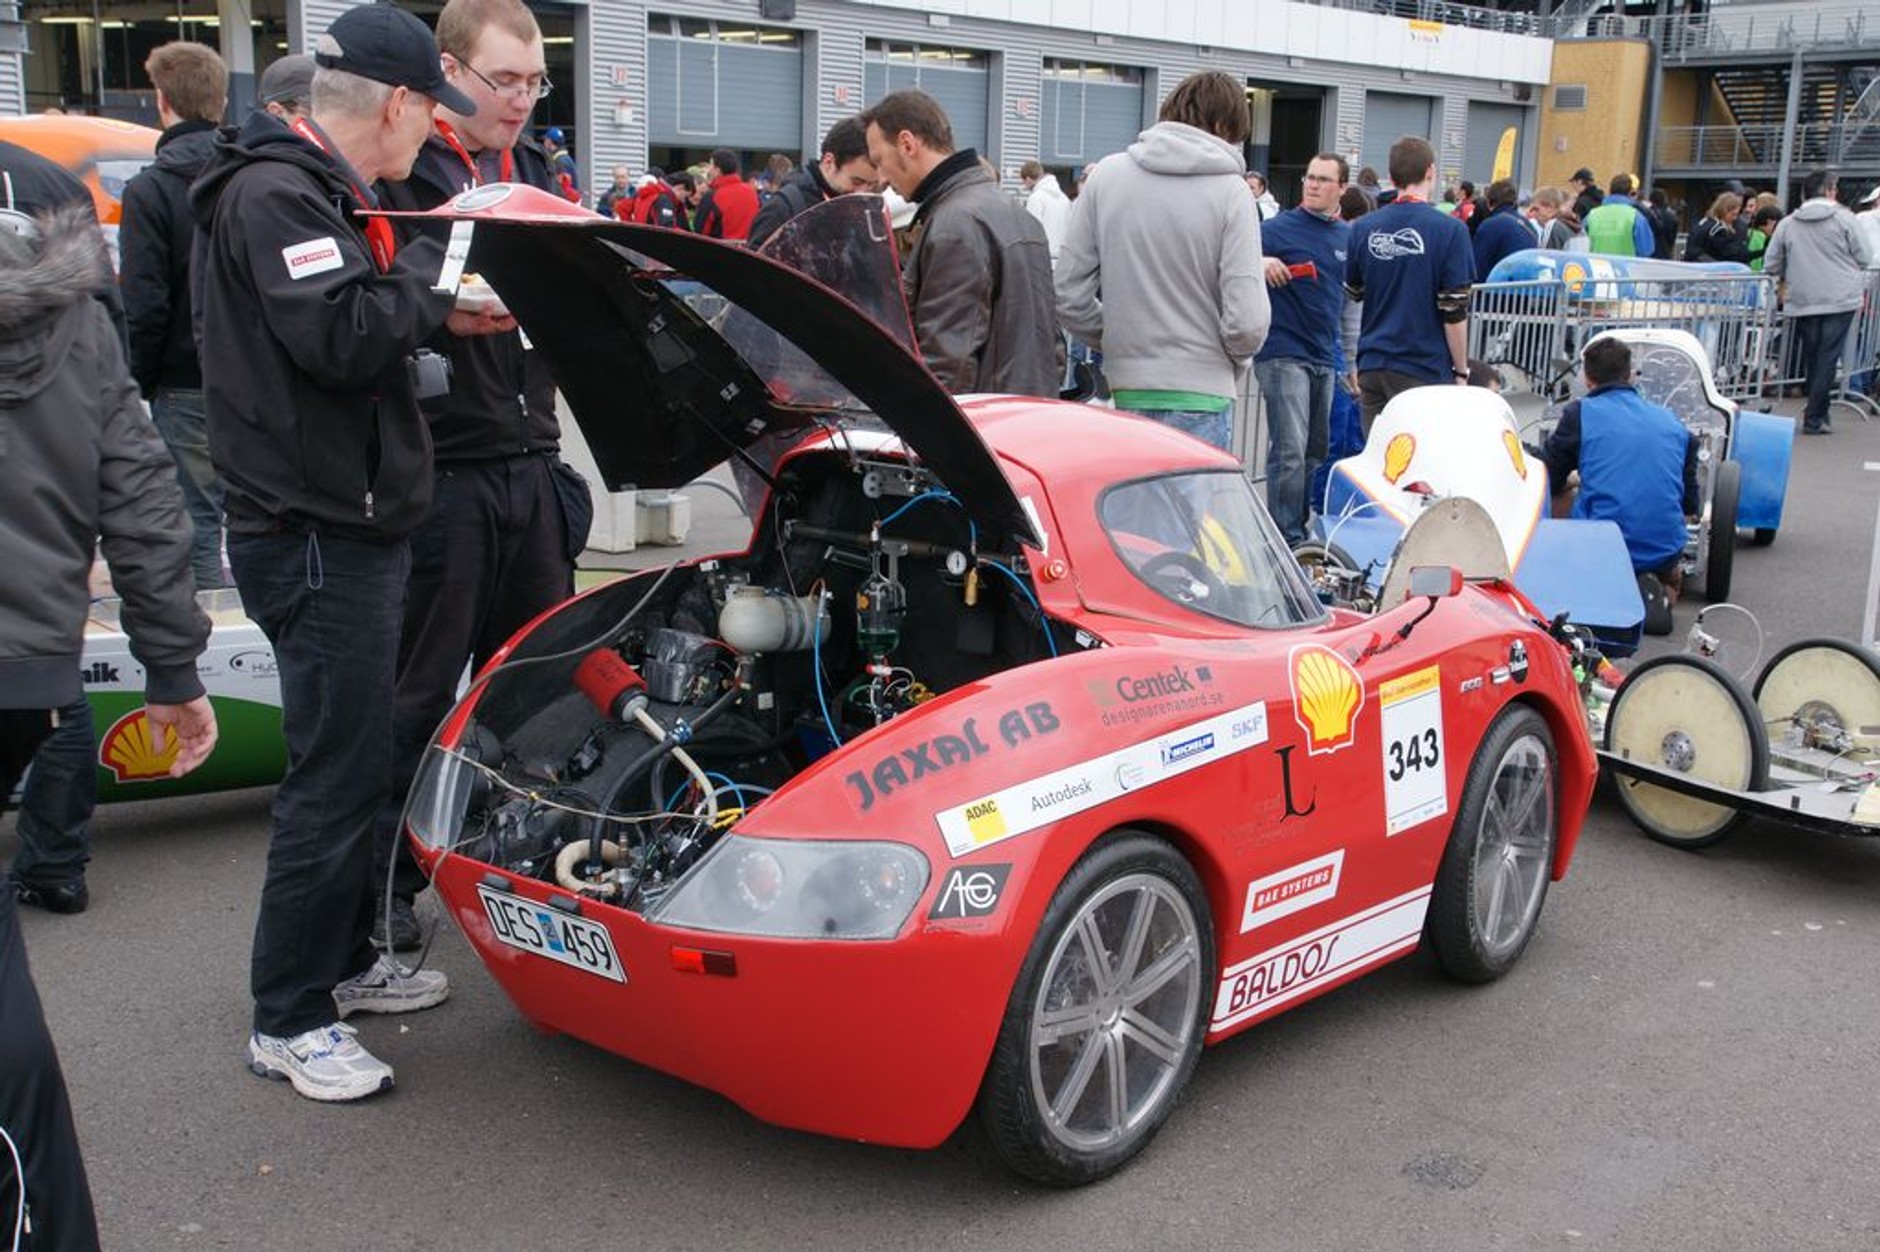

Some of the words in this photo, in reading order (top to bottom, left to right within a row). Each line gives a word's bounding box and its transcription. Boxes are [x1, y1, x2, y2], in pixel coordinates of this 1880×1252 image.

[1116, 665, 1195, 703] Centek
[999, 702, 1060, 748] AB
[1101, 692, 1224, 727] designarenanord.se
[1231, 714, 1264, 739] SKF
[1388, 727, 1440, 782] 343
[965, 800, 998, 822] ADAC
[1030, 778, 1093, 813] Autodesk
[1257, 888, 1280, 907] BAE
[1279, 869, 1330, 898] SYSTEMS
[483, 895, 544, 948] DES
[561, 919, 612, 971] 459
[1228, 934, 1340, 1013] BALDOS
